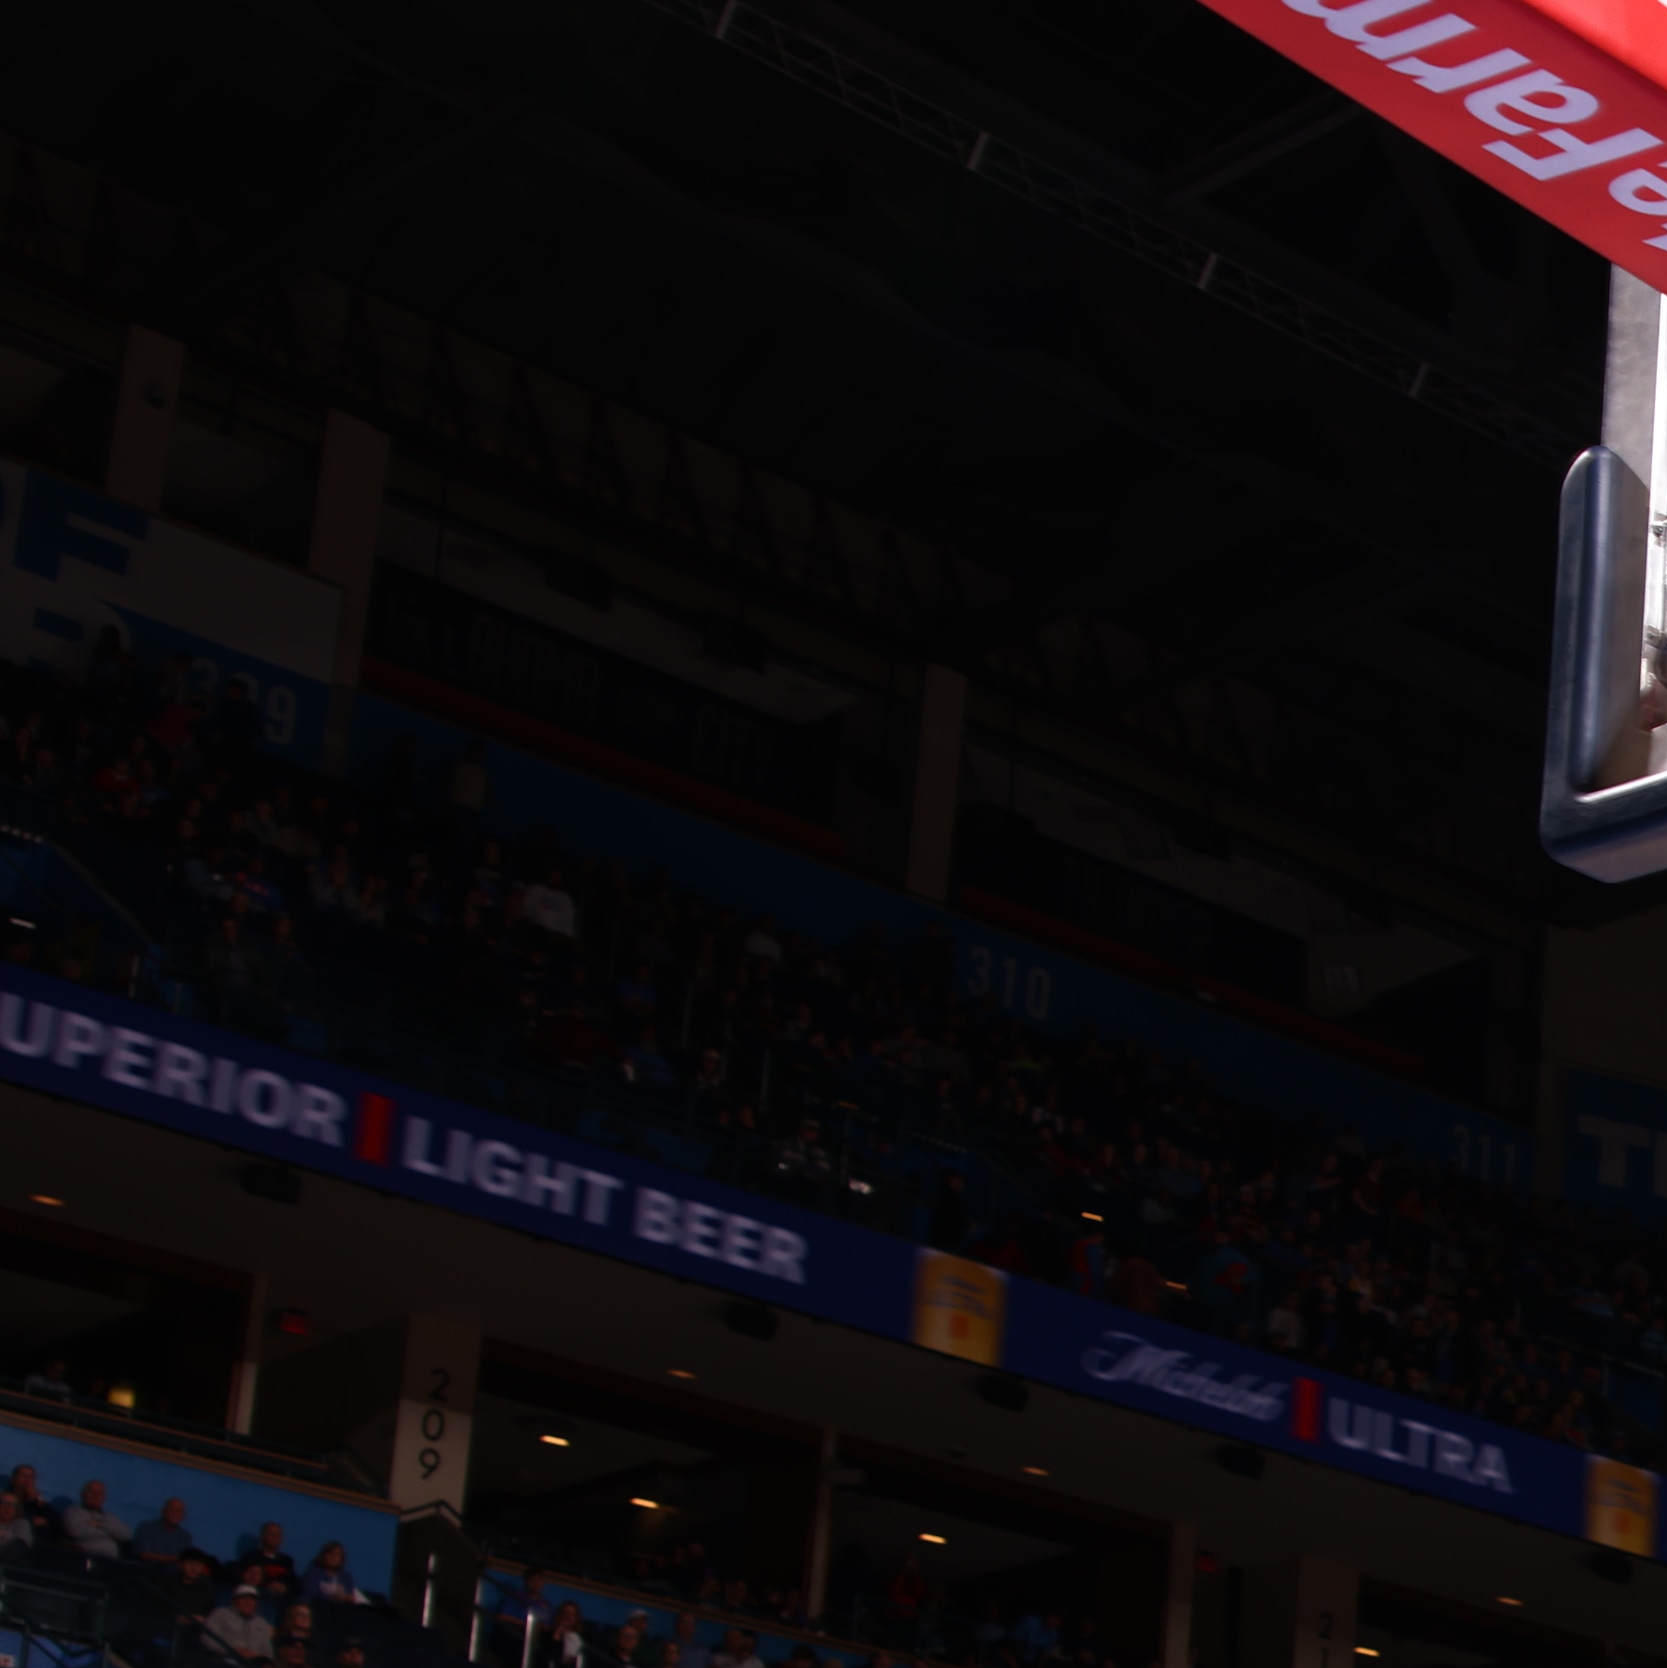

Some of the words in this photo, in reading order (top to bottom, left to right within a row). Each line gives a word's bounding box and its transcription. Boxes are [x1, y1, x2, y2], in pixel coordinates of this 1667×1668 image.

[967, 943, 1052, 1022] 310
[402, 1113, 627, 1227] LIGHT
[632, 1185, 809, 1286] BEER
[1452, 1121, 1517, 1183] 311
[418, 1368, 450, 1481] 209
[1328, 1397, 1517, 1496] ULTRA
